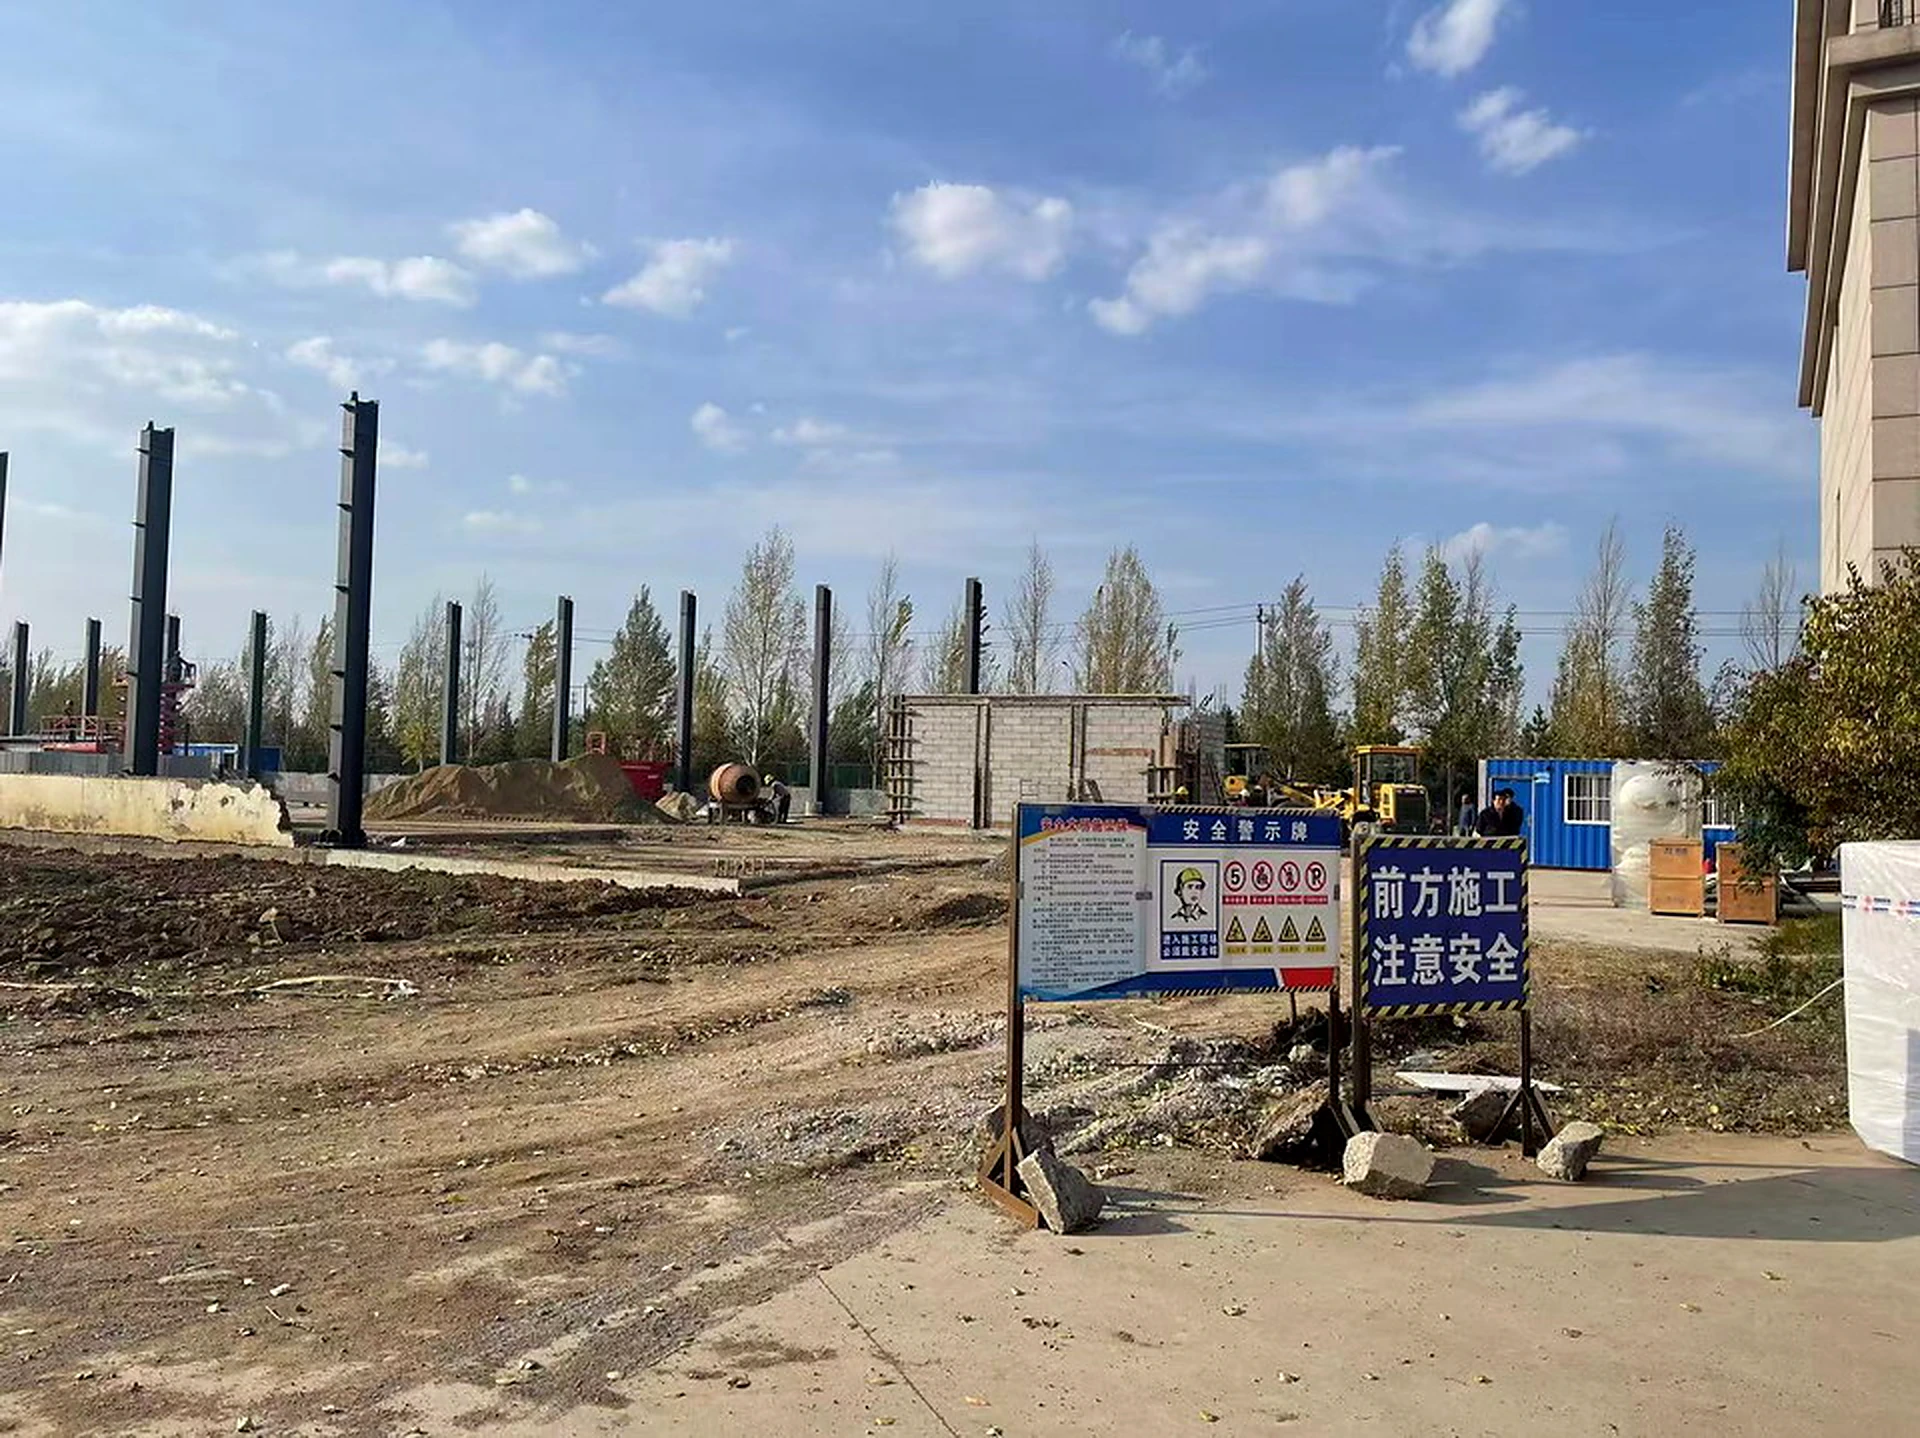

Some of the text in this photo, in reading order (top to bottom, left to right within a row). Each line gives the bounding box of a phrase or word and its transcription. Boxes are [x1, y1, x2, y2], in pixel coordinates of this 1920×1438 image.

[1183, 818, 1308, 841] 安全警示牌
[1230, 868, 1241, 886] 5
[1371, 865, 1518, 919] 前方施工
[1371, 931, 1519, 986] 注意安全
